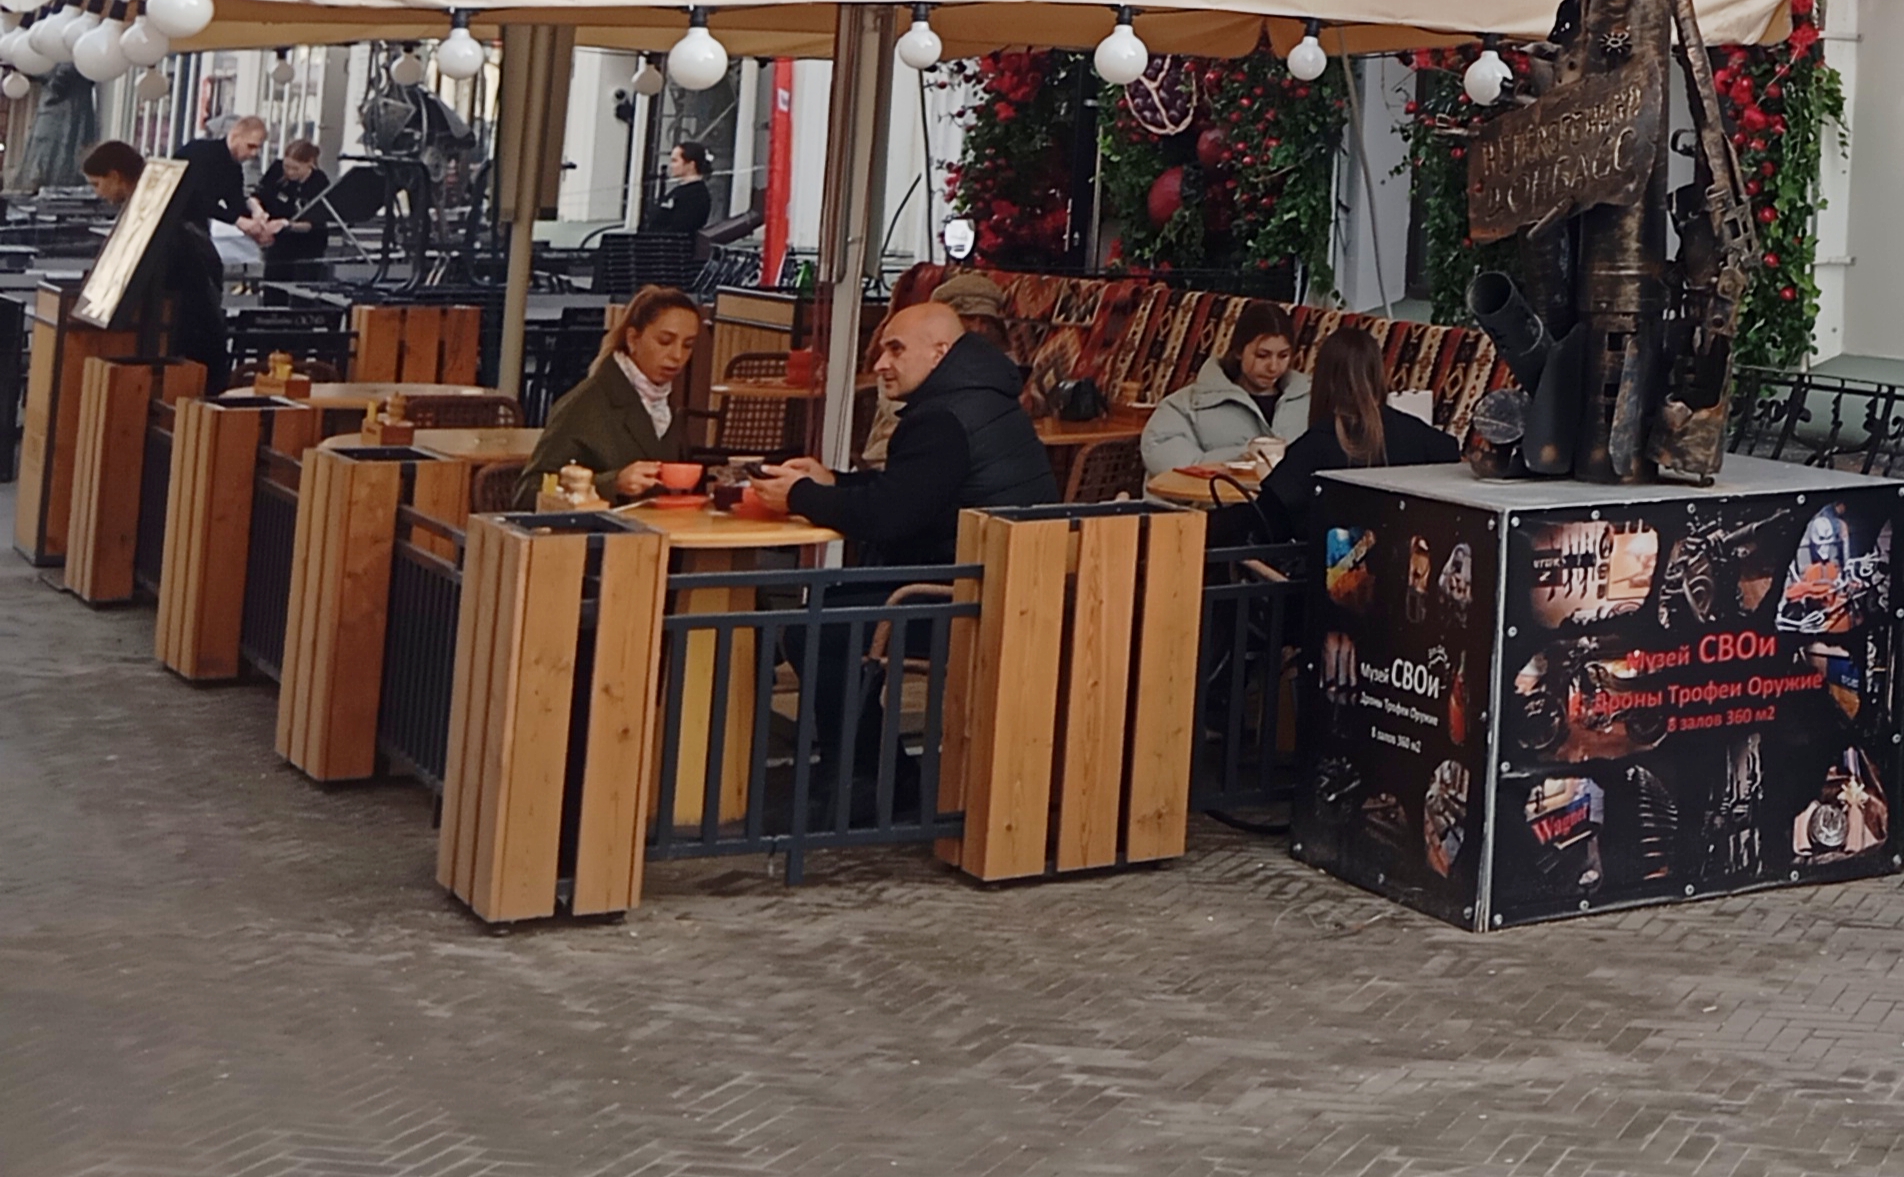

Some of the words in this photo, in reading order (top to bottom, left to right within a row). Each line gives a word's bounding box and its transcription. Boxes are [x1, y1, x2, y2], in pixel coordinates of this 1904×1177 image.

[1626, 645, 1690, 672] Музей
[1699, 631, 1777, 664] СВОи
[1391, 658, 1440, 700] СВОи
[1667, 679, 1743, 707] Трофеи
[1747, 672, 1824, 698] Оружие
[1679, 713, 1722, 732] залов
[1726, 708, 1752, 726] 360
[1755, 705, 1776, 722] м2
